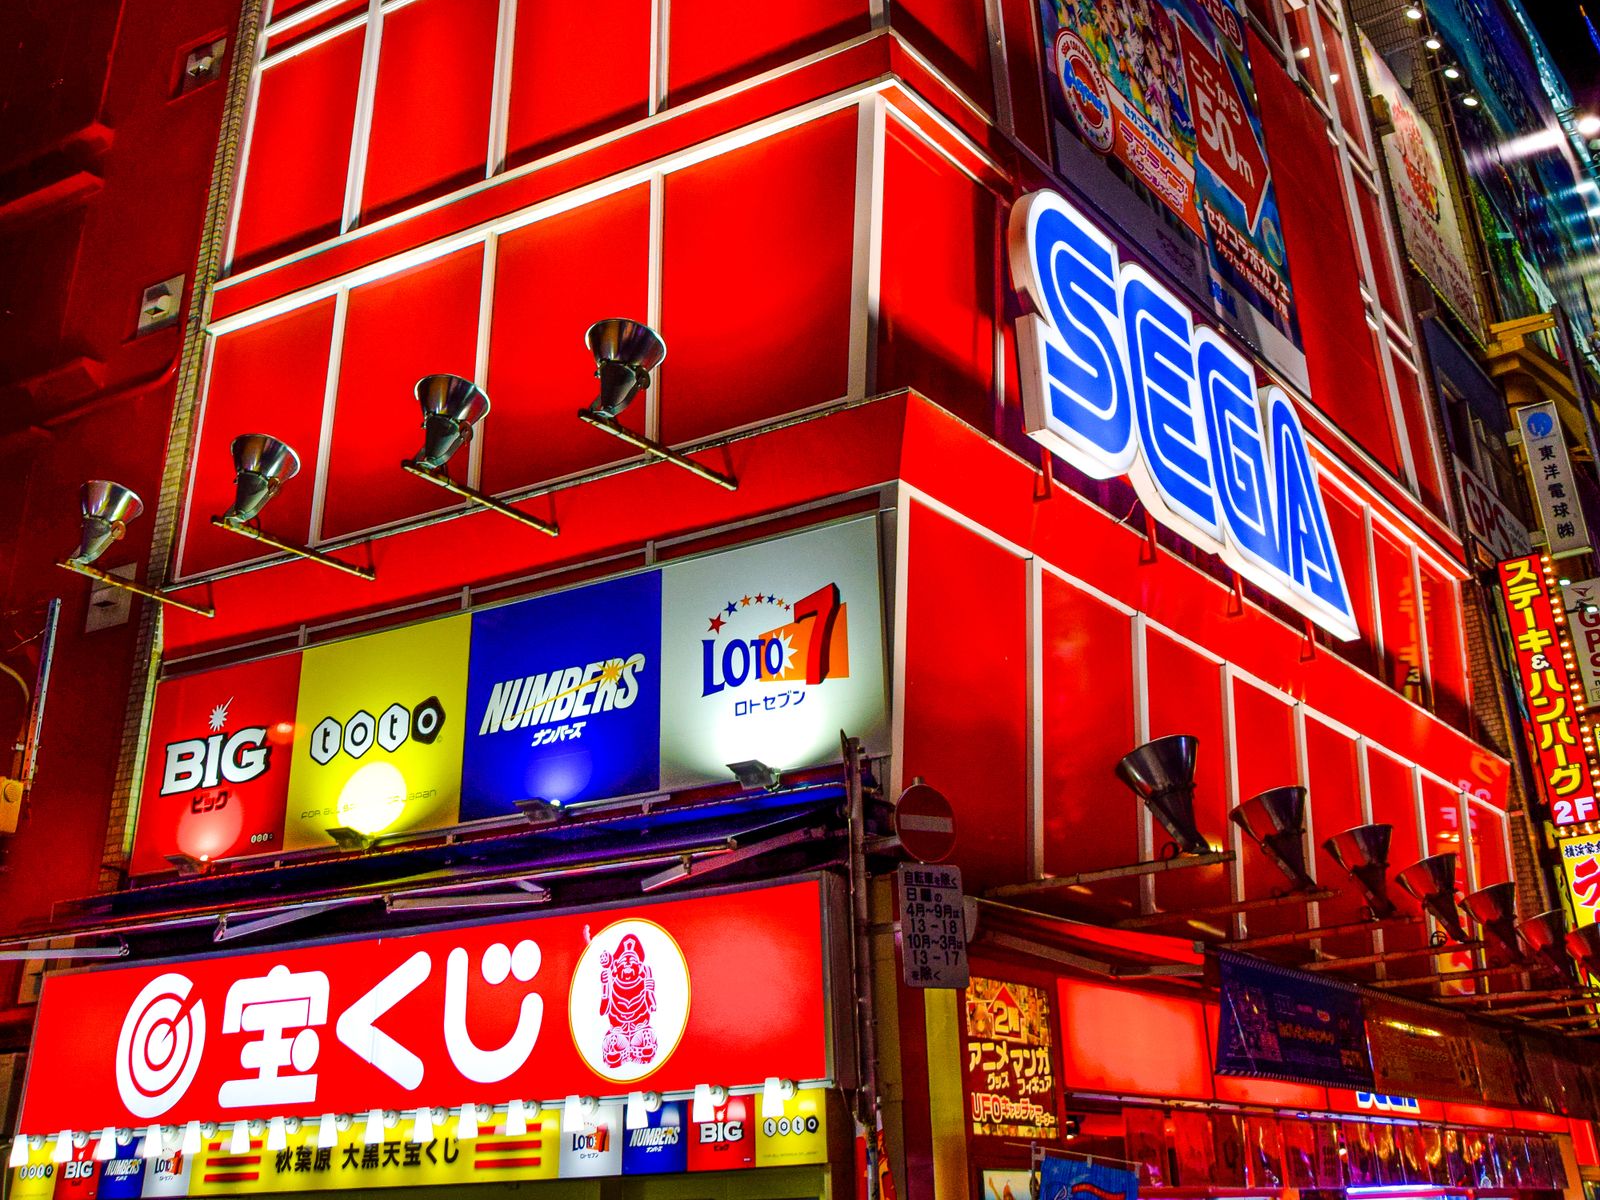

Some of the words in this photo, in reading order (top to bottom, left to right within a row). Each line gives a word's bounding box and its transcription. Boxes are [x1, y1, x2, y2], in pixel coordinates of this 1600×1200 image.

[1187, 48, 1243, 126] ここから
[1123, 103, 1177, 164] セガコラボカフェ
[1195, 94, 1255, 189] 50m
[1203, 200, 1291, 303] セガコラボカフェ
[1028, 196, 1355, 632] SEGA
[1461, 472, 1512, 558] GPS
[701, 636, 783, 698] LOTO
[793, 582, 841, 685] 7
[479, 653, 645, 736] NUMBERS
[734, 690, 806, 717] ロトセブン
[309, 695, 446, 765] toto
[531, 721, 586, 747] ナンバーズ
[160, 726, 271, 797] BIG
[1553, 795, 1595, 826] 2F
[218, 940, 545, 1110] 宝くじ
[275, 1145, 332, 1174] 秋葉原
[342, 1136, 460, 1171] 大黒天宝くじ
[629, 1126, 680, 1147] NUMBERS
[699, 1120, 744, 1143] BIG
[763, 1115, 819, 1138] toto
[19, 1163, 54, 1181] toto
[64, 1159, 95, 1180] BIG
[105, 1158, 142, 1177] NUMBERS
